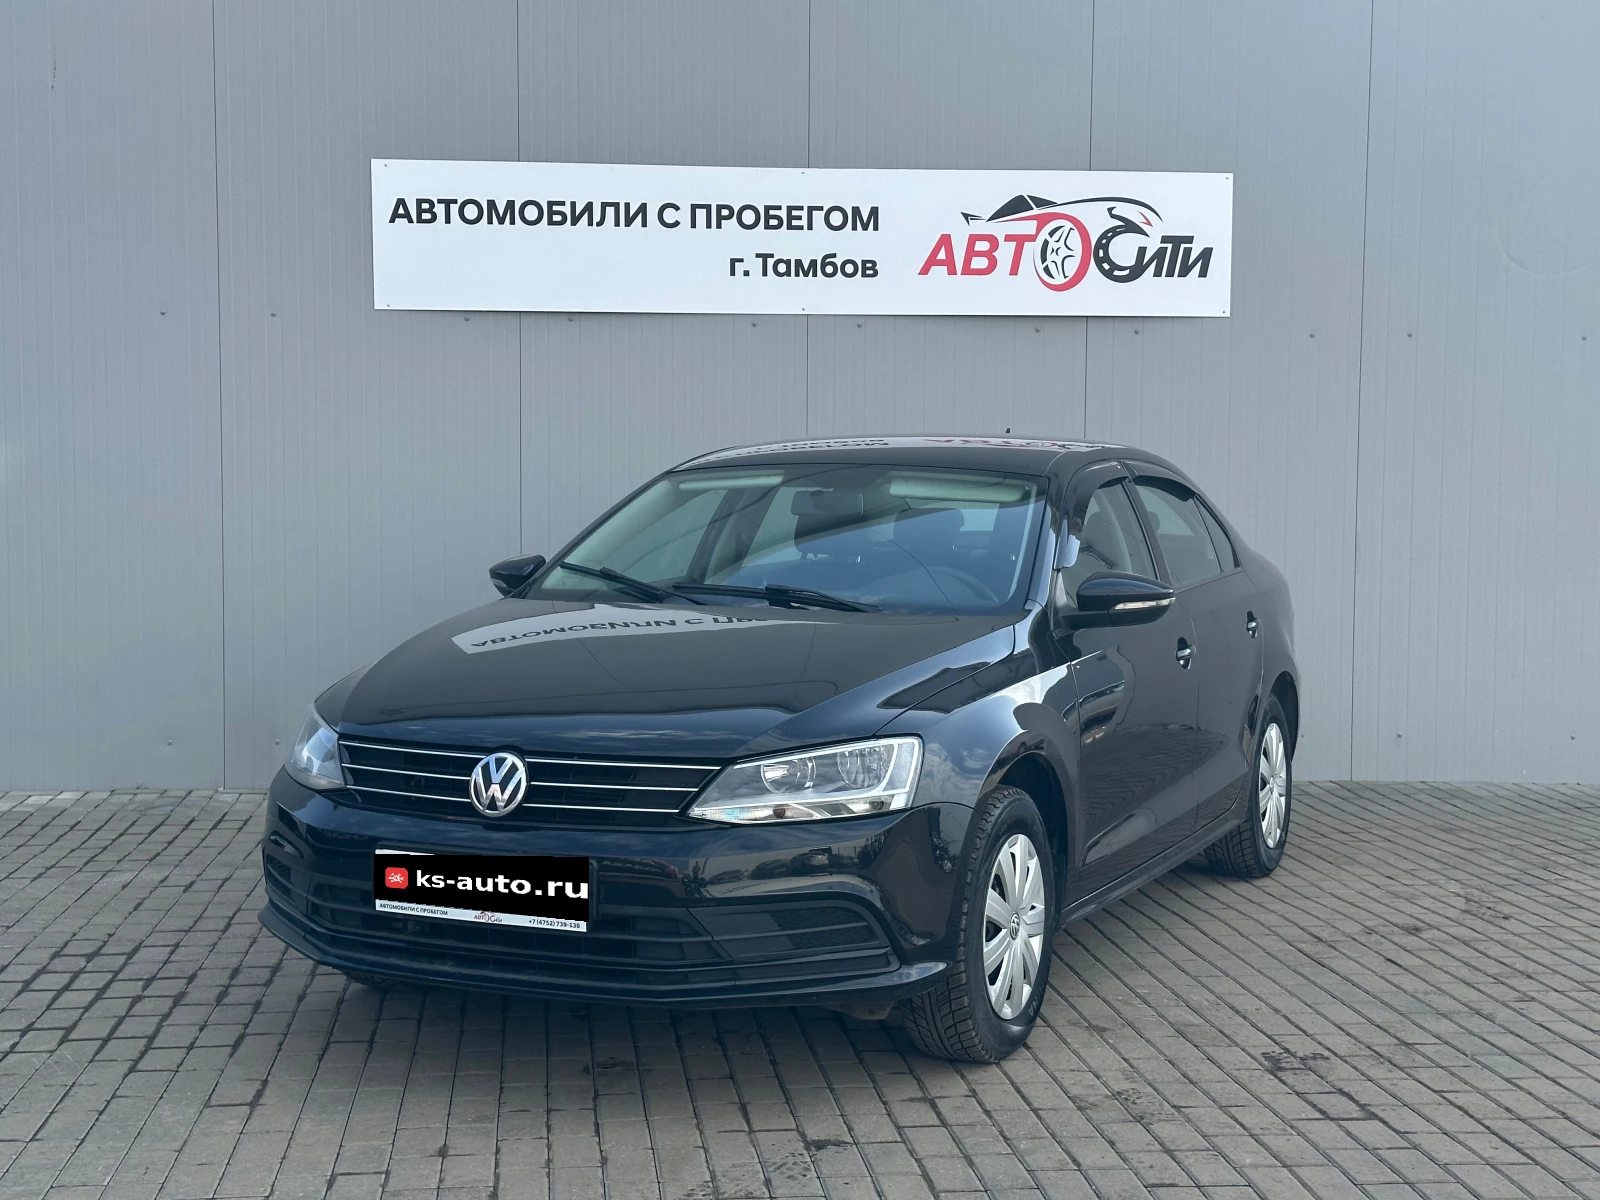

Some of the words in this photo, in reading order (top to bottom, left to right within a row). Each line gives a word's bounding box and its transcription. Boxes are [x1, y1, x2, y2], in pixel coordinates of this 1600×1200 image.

[389, 197, 648, 228] АВТОМОБИЛИ
[657, 202, 681, 229] С
[690, 203, 879, 232] ПРОБЕГОМ
[729, 257, 750, 277] г.
[754, 252, 879, 279] Тамбов
[379, 903, 415, 912] АВТОМОБИЛИ
[420, 907, 448, 916] ПРОБЕГОМ
